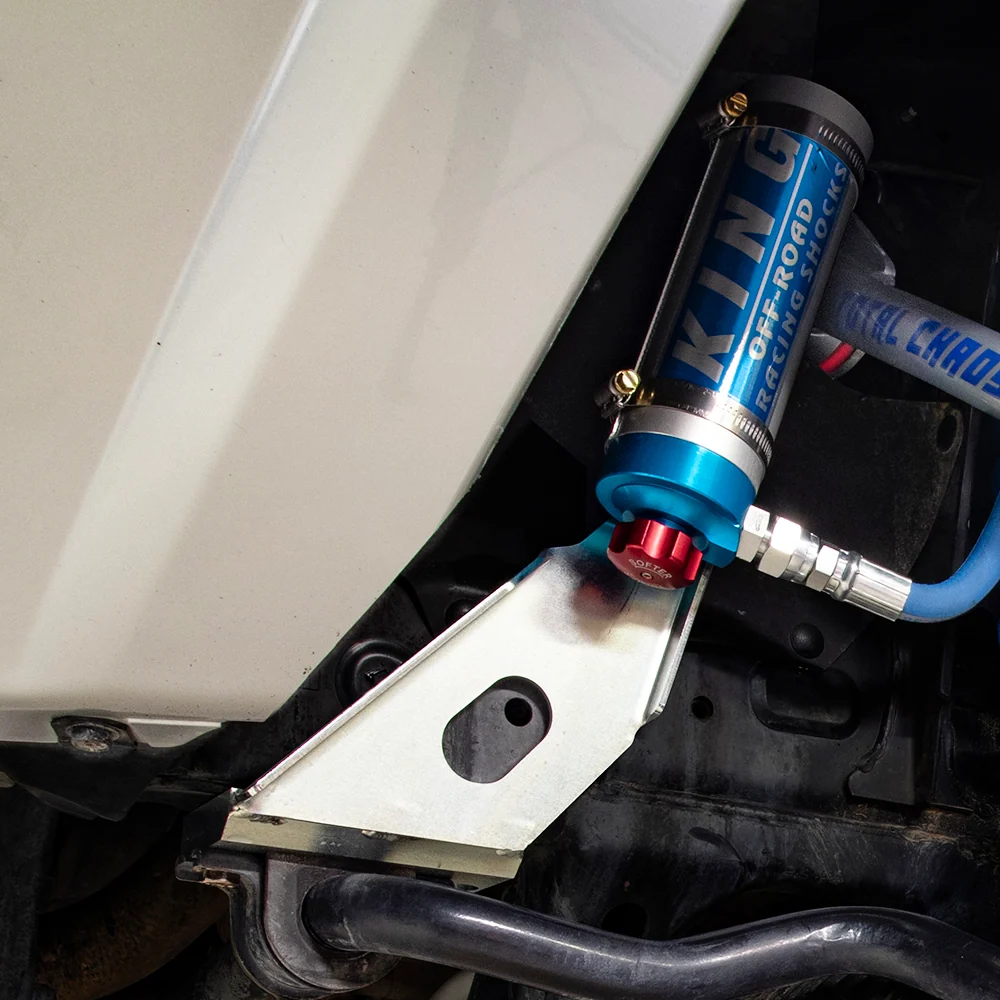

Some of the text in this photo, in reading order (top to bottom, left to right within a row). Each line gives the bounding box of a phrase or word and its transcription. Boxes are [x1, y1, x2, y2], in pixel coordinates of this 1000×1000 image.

[672, 127, 801, 384] KING
[749, 198, 813, 361] OFF-ROAD
[755, 162, 849, 412] RACING SHOCKS
[629, 559, 672, 579] SOFTER
